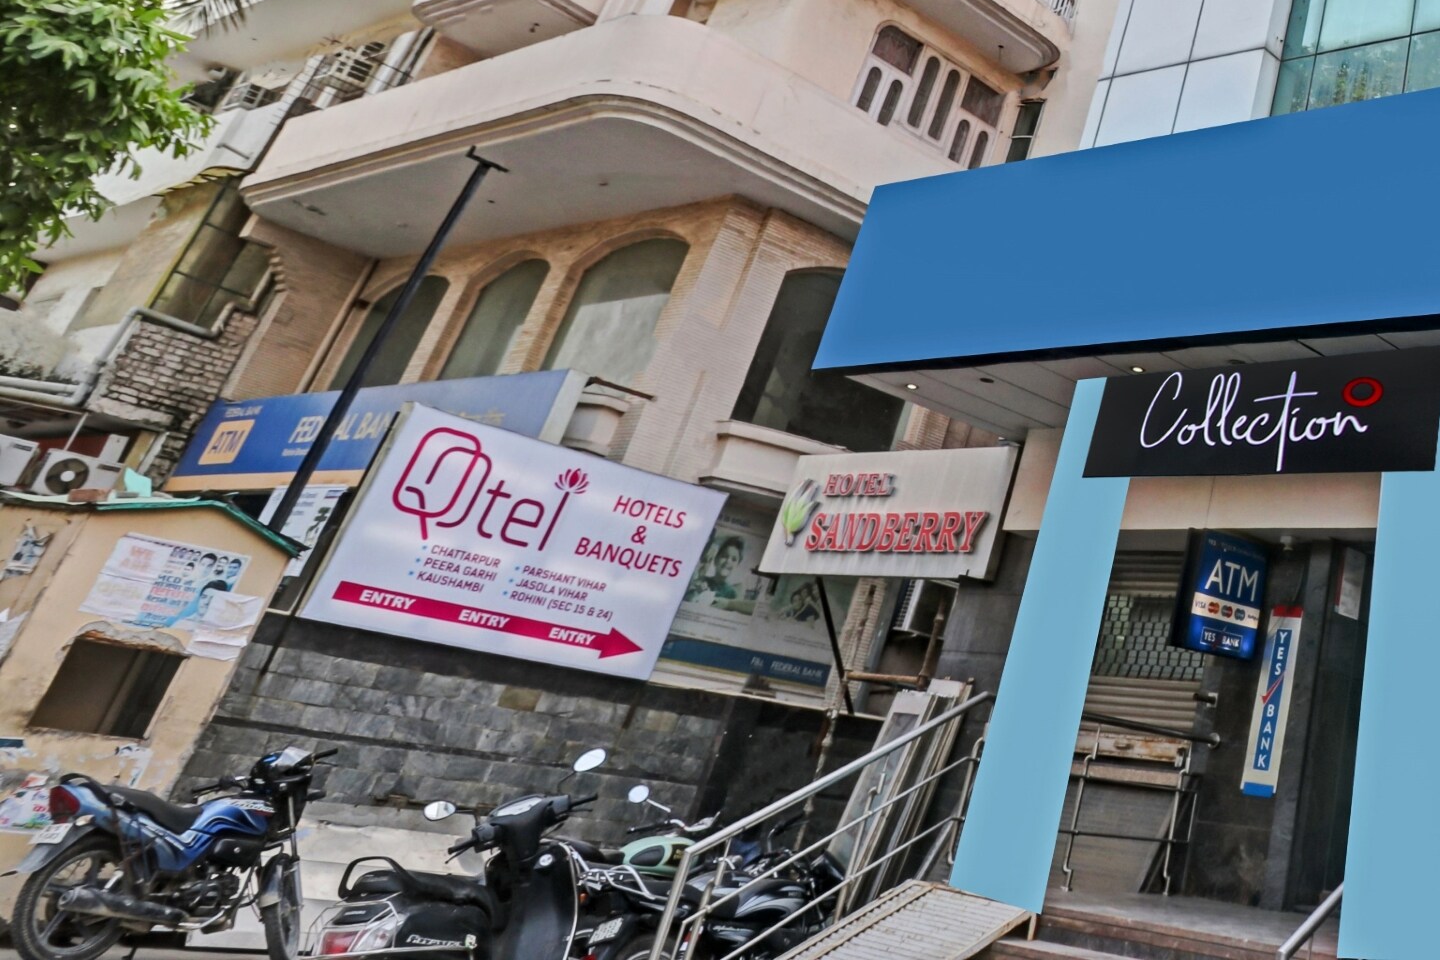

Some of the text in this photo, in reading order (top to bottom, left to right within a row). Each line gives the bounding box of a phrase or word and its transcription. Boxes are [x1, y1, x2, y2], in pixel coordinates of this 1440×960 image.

[288, 411, 395, 443] FEDAL BAN
[1140, 371, 1369, 472] Collection
[208, 429, 245, 454] ATM
[823, 473, 894, 496] HOTEL
[613, 495, 687, 529] HOTELS
[631, 525, 647, 544] &
[804, 511, 988, 553] SANDBERRY
[430, 544, 502, 568] CHATTARPUR
[574, 537, 682, 578] BANQUETS
[416, 570, 485, 593] KAUSHAMBI
[423, 557, 498, 582] PEERA GARHI
[522, 565, 607, 592] PARSHANT VIHAR
[1204, 558, 1259, 602] ATM
[358, 589, 417, 610] ENTRY
[515, 578, 588, 601] JASOLA VIHAR
[509, 590, 547, 606] ROHINI
[572, 604, 586, 615] 15
[586, 607, 596, 617] &
[458, 608, 510, 629] ENTRY
[548, 626, 596, 646] ENTRY
[1204, 631, 1240, 648] YES BANK
[1257, 631, 1288, 768] YES BANK
